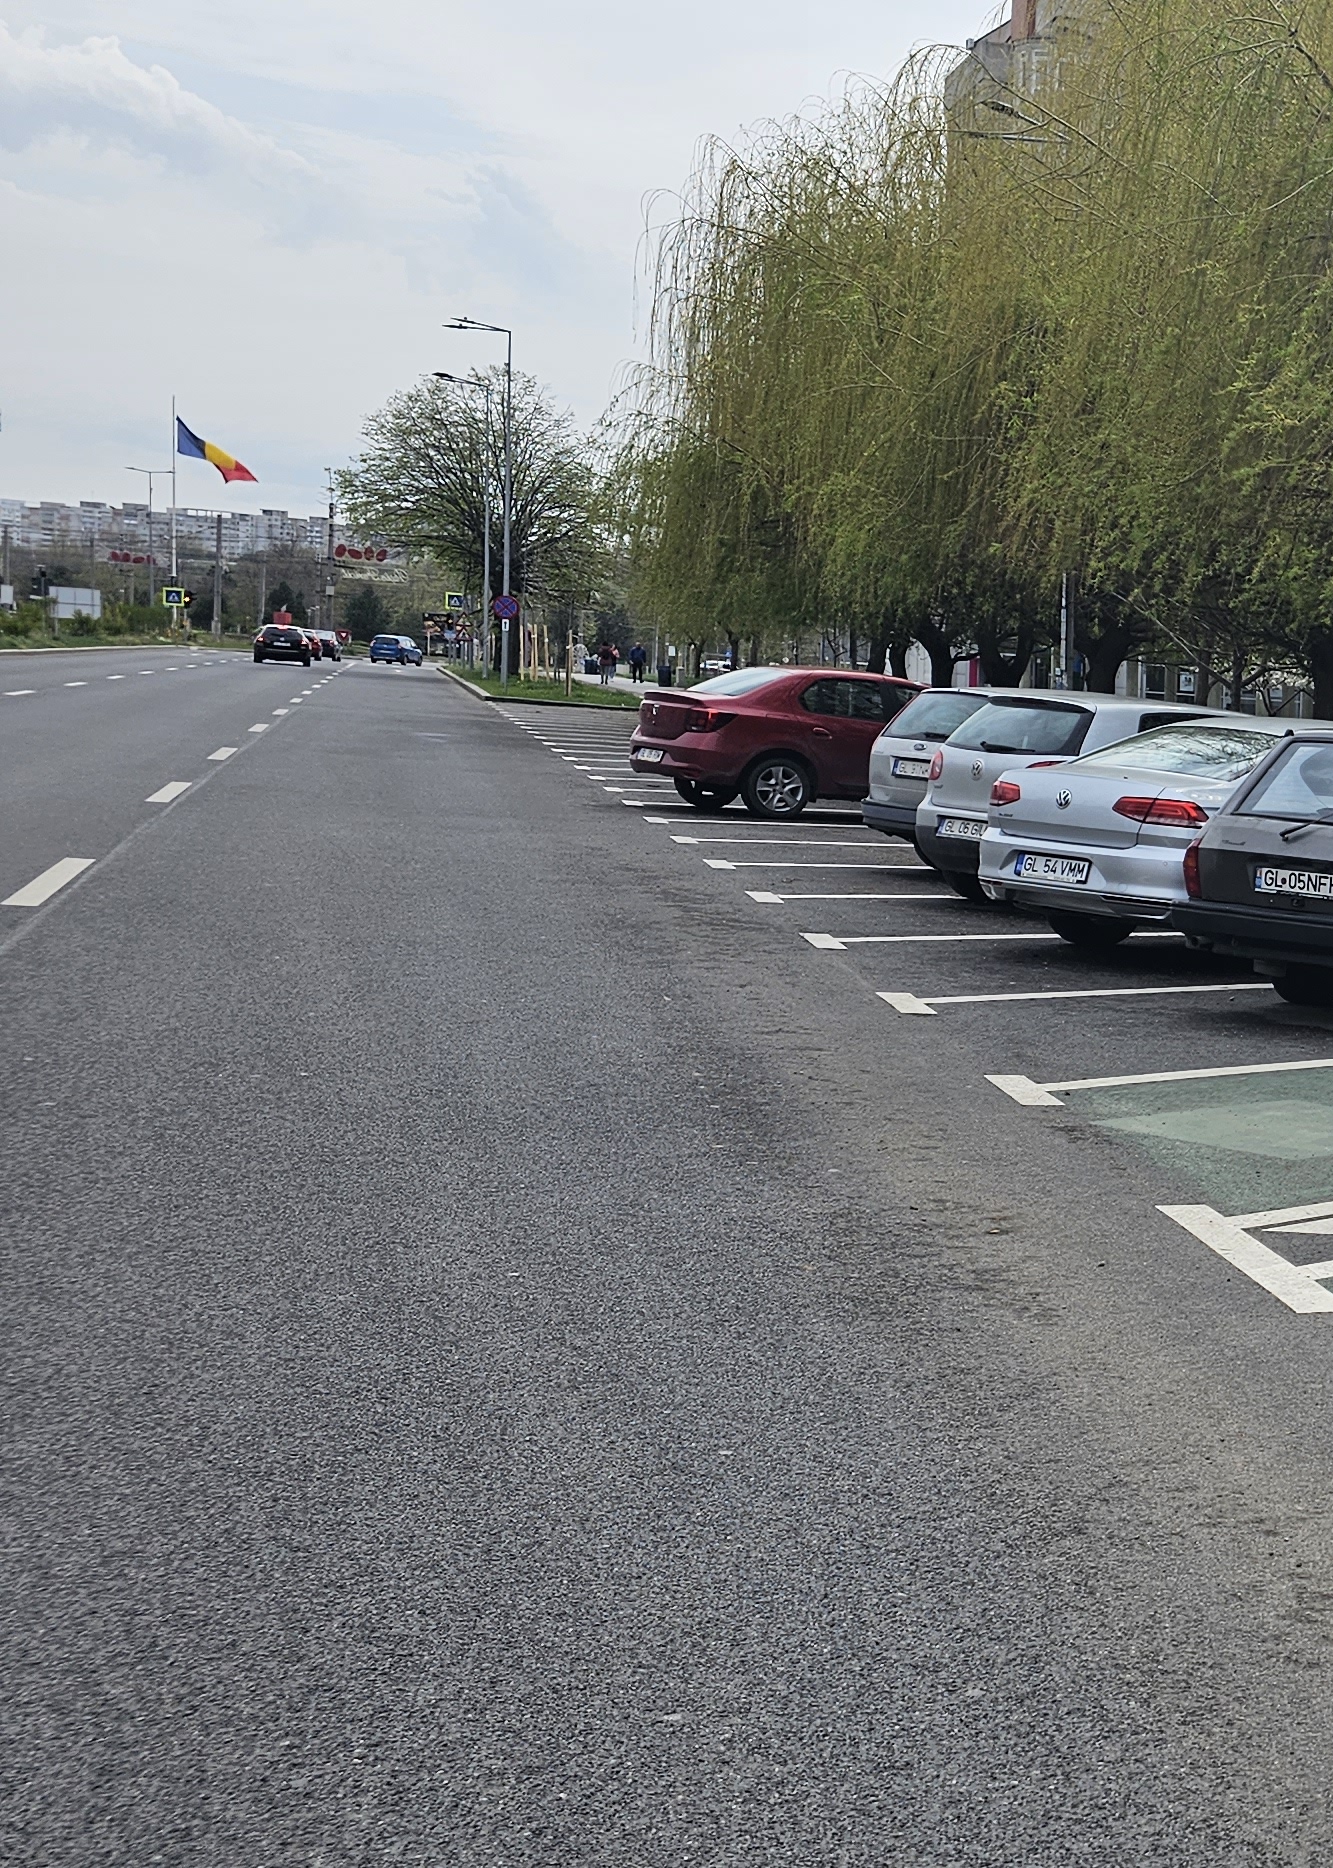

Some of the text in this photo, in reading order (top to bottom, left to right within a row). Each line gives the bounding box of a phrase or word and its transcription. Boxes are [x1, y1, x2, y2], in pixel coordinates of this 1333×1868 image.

[944, 820, 955, 833] GL
[1023, 857, 1086, 879] GL 54 VMM
